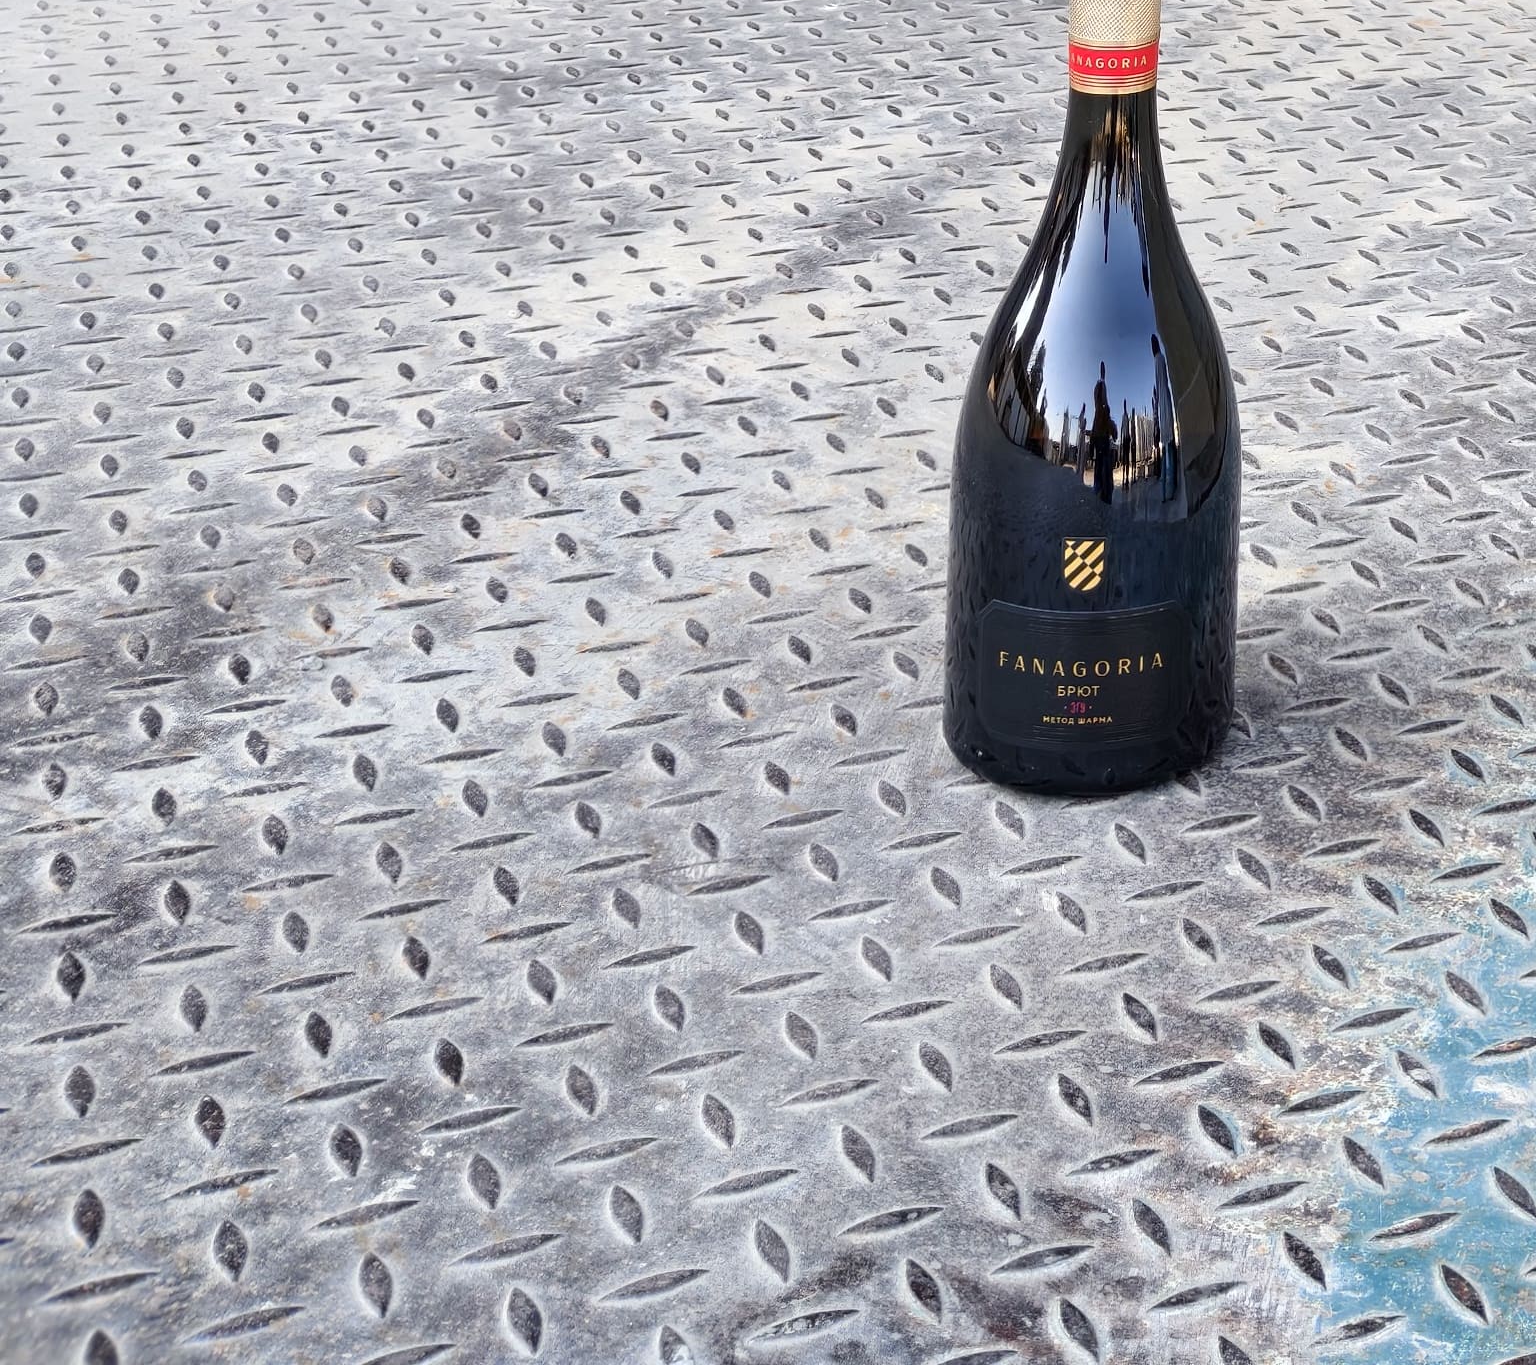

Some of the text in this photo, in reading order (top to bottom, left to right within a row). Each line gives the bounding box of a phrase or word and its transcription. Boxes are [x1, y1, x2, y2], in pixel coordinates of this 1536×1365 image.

[1070, 52, 1148, 69] ANAGORIA
[998, 650, 1164, 678] FANAGORIA
[1056, 684, 1101, 698] БРЮТ
